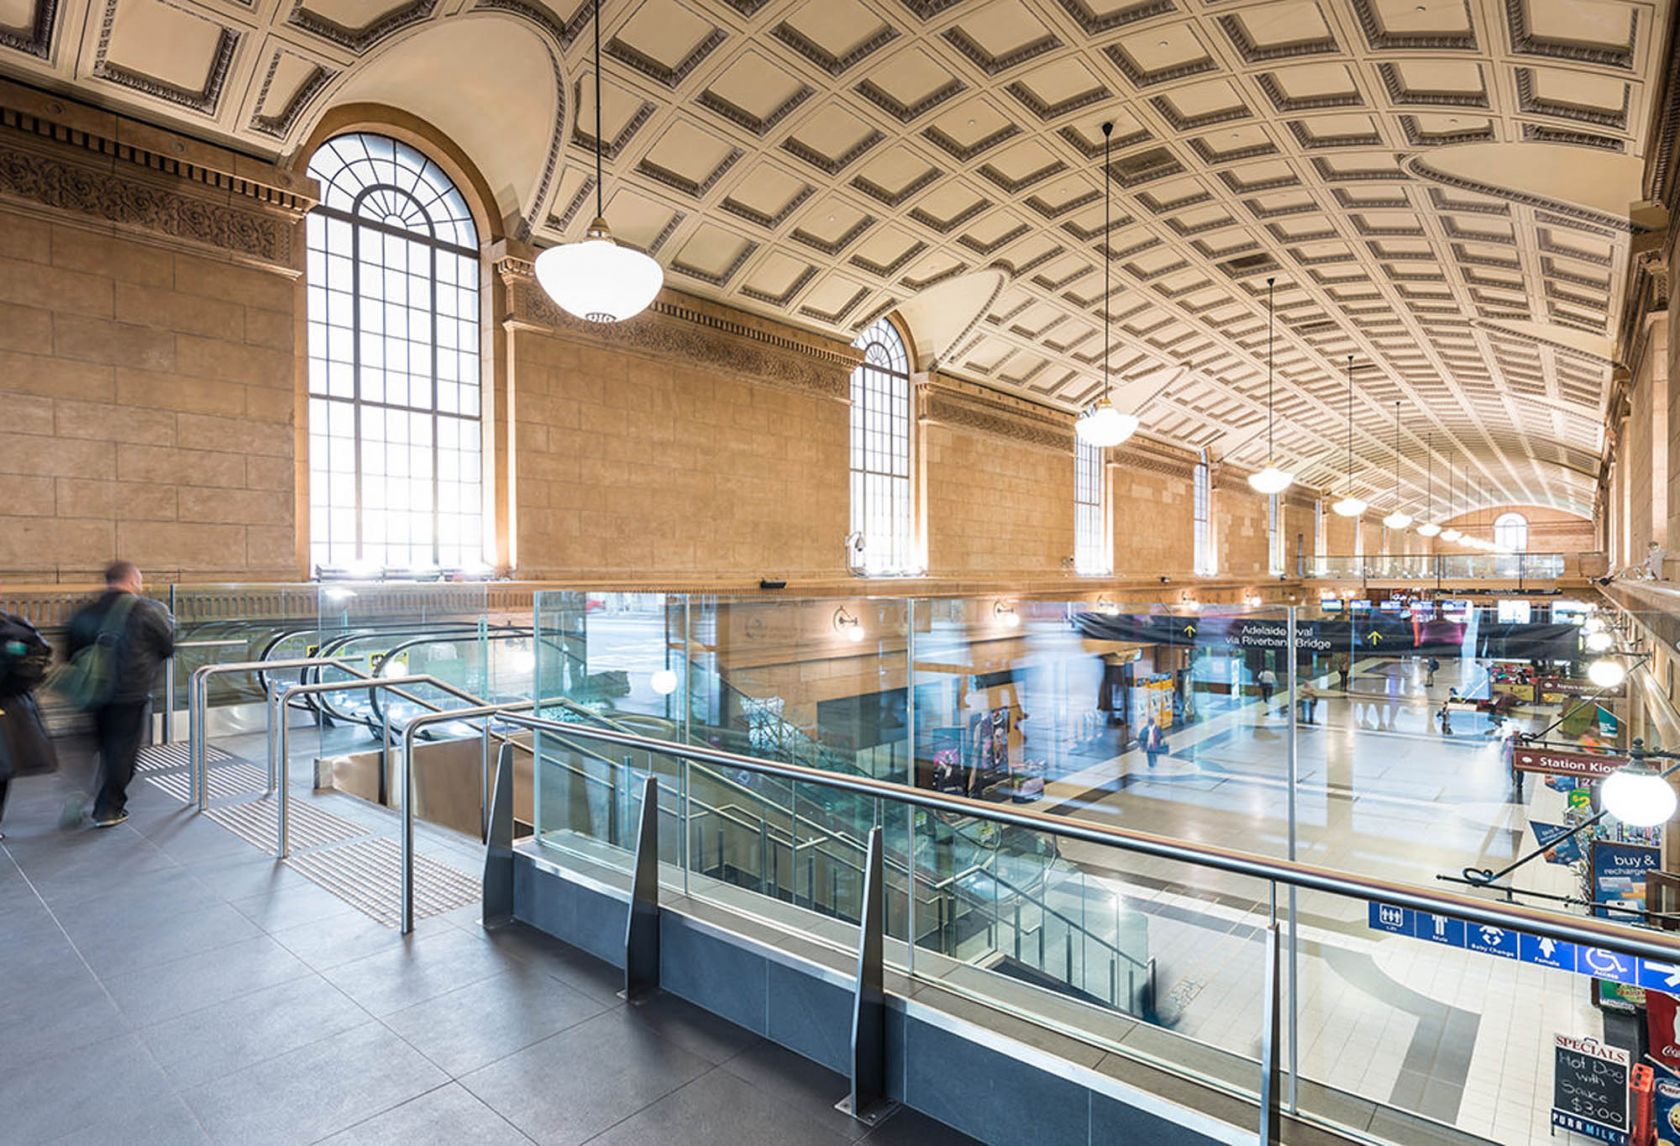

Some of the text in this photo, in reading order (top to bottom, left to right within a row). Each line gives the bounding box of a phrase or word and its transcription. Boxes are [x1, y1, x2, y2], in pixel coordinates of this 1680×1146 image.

[1241, 625, 1314, 637] Adelaide val
[1225, 636, 1332, 650] via Riverban Bridge
[1540, 756, 1586, 771] Station
[1614, 854, 1656, 868] buy &
[1471, 943, 1515, 958] Baby Change
[1534, 956, 1561, 967] Female
[1593, 970, 1619, 980] Access
[1556, 1035, 1626, 1063] SPECIALS
[1559, 1051, 1624, 1085] Hot Dog
[1575, 1071, 1606, 1088] with
[1560, 1079, 1608, 1104] Sauce
[1585, 1123, 1616, 1142] MILK
